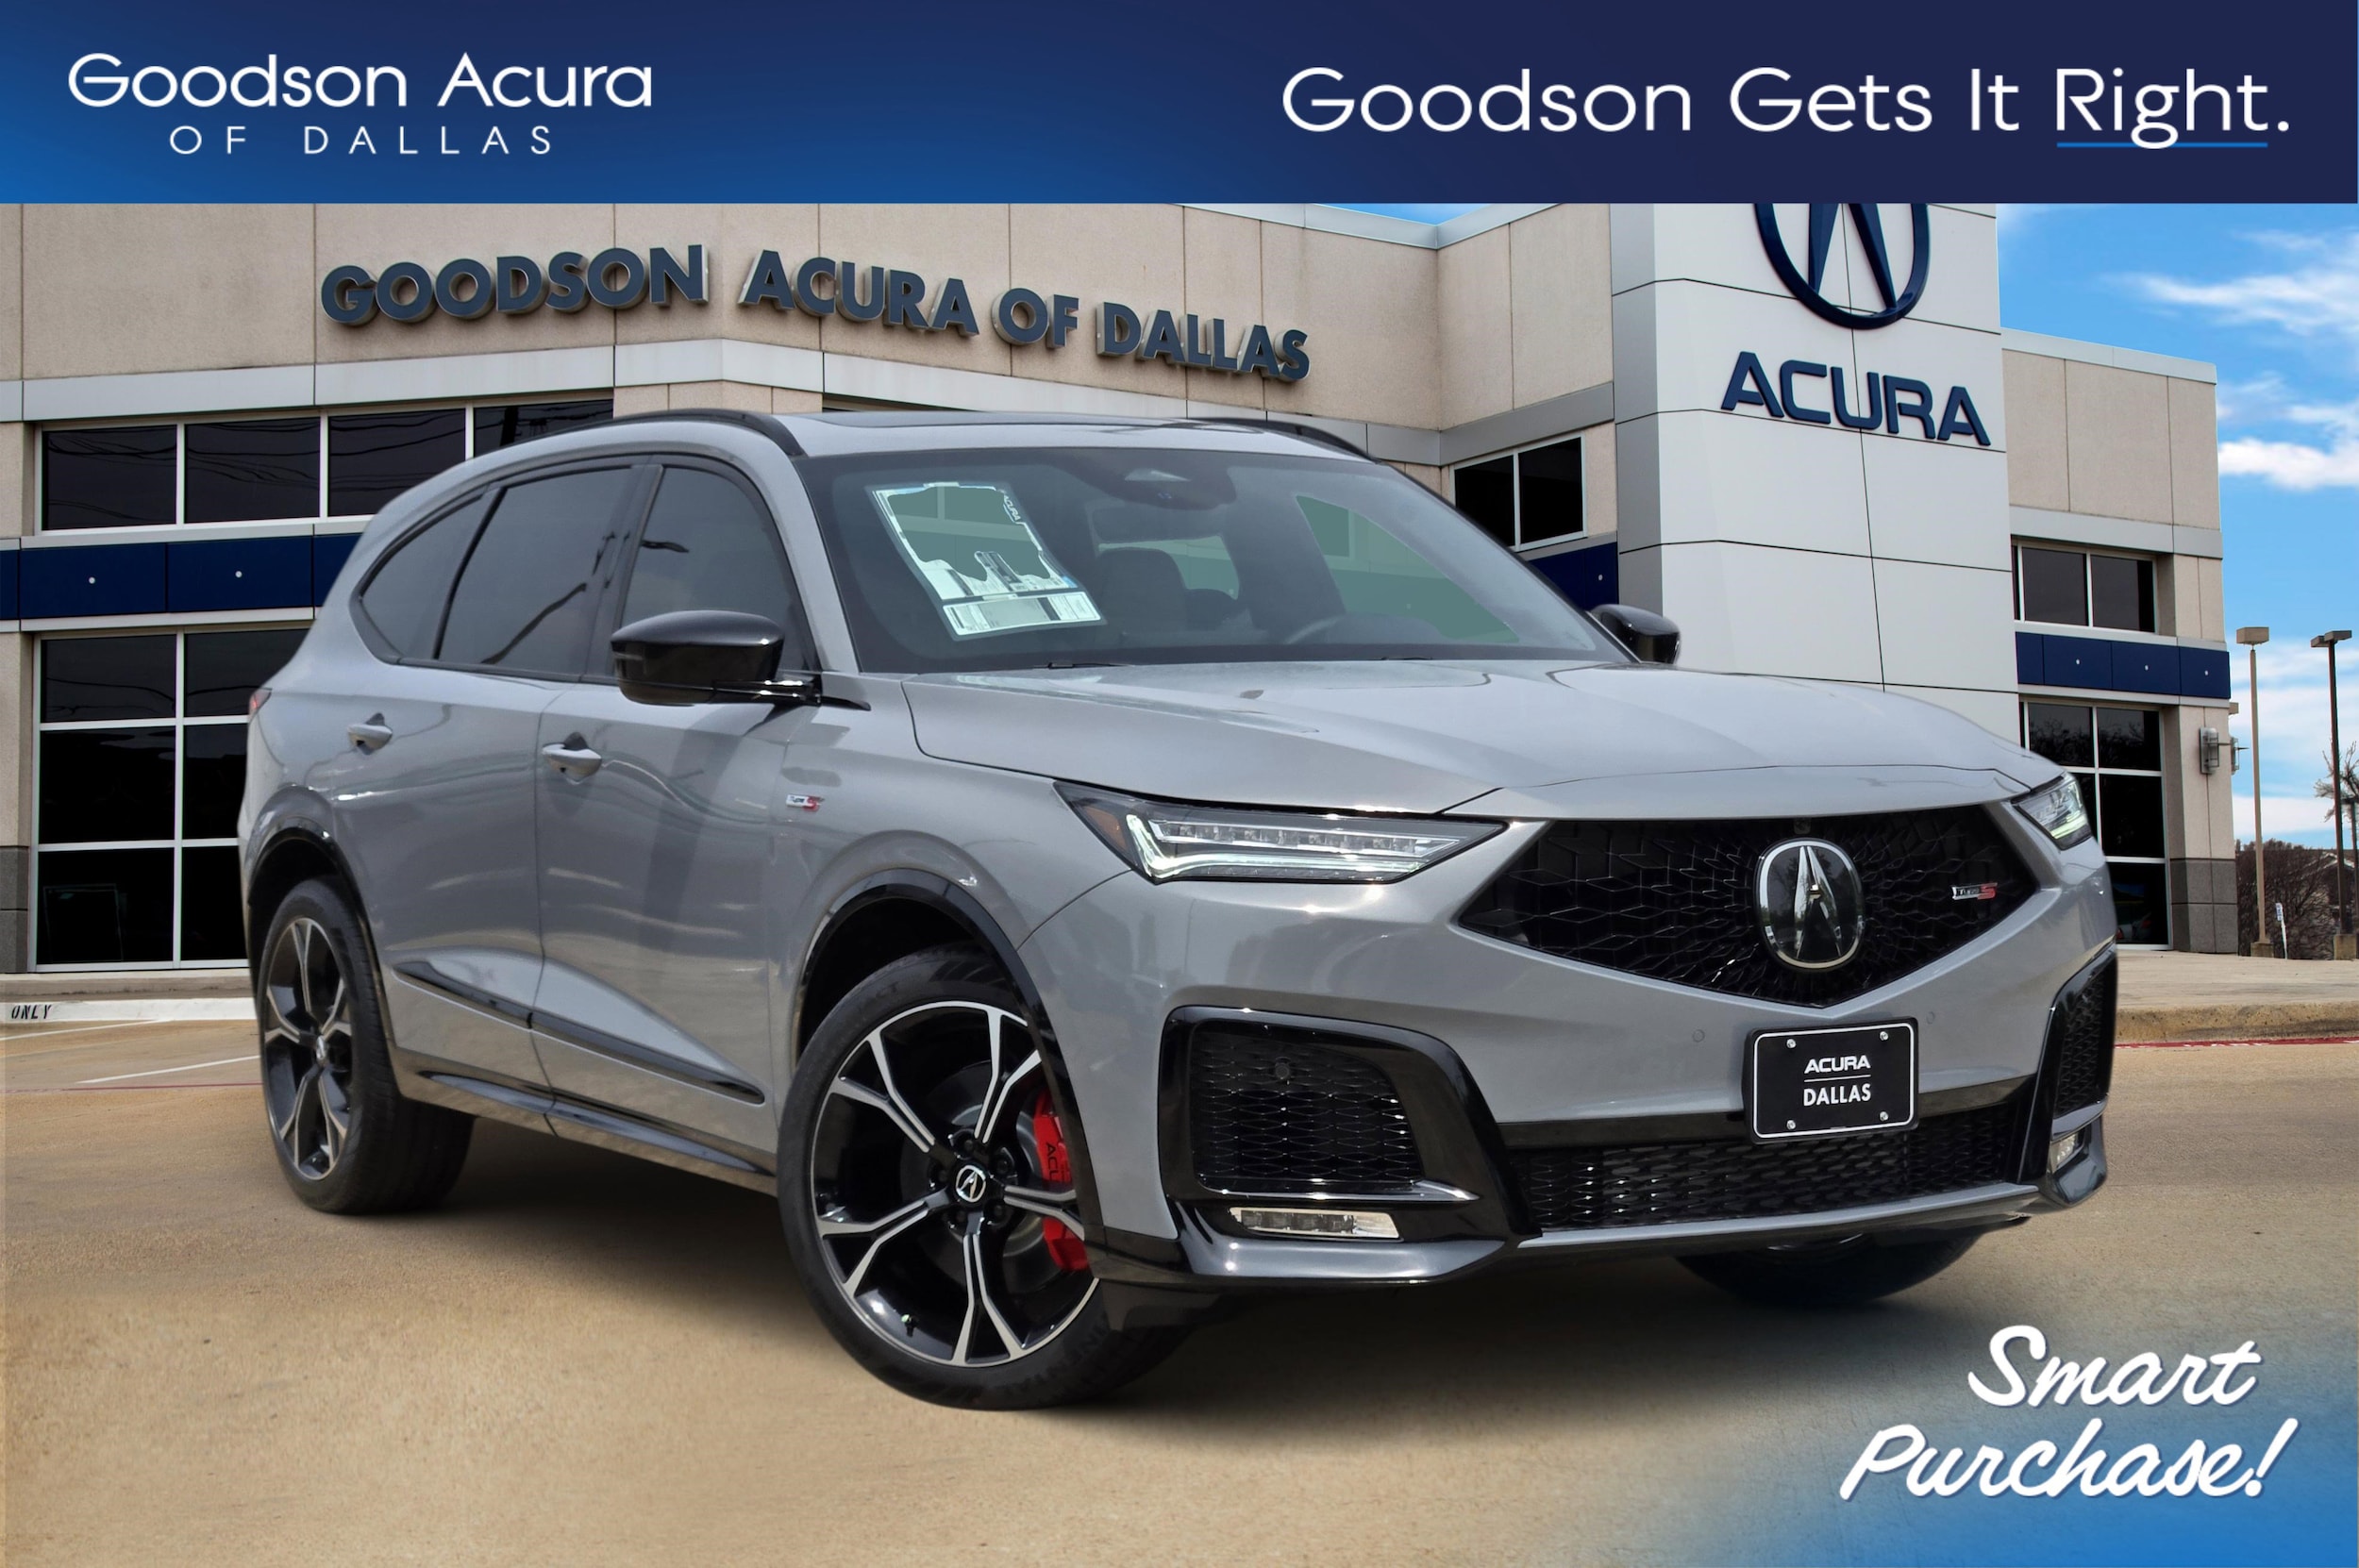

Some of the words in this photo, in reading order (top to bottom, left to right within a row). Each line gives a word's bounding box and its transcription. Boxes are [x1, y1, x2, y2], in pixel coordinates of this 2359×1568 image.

[321, 244, 709, 325] GOODSON
[739, 249, 979, 338] ACURA
[992, 288, 1079, 349] OF
[1096, 301, 1311, 382] DALLAS
[1720, 351, 1991, 446] ACURA
[11, 1005, 52, 1019] ONLY
[1803, 1055, 1871, 1074] ACURA
[1803, 1082, 1872, 1107] DALLAS
